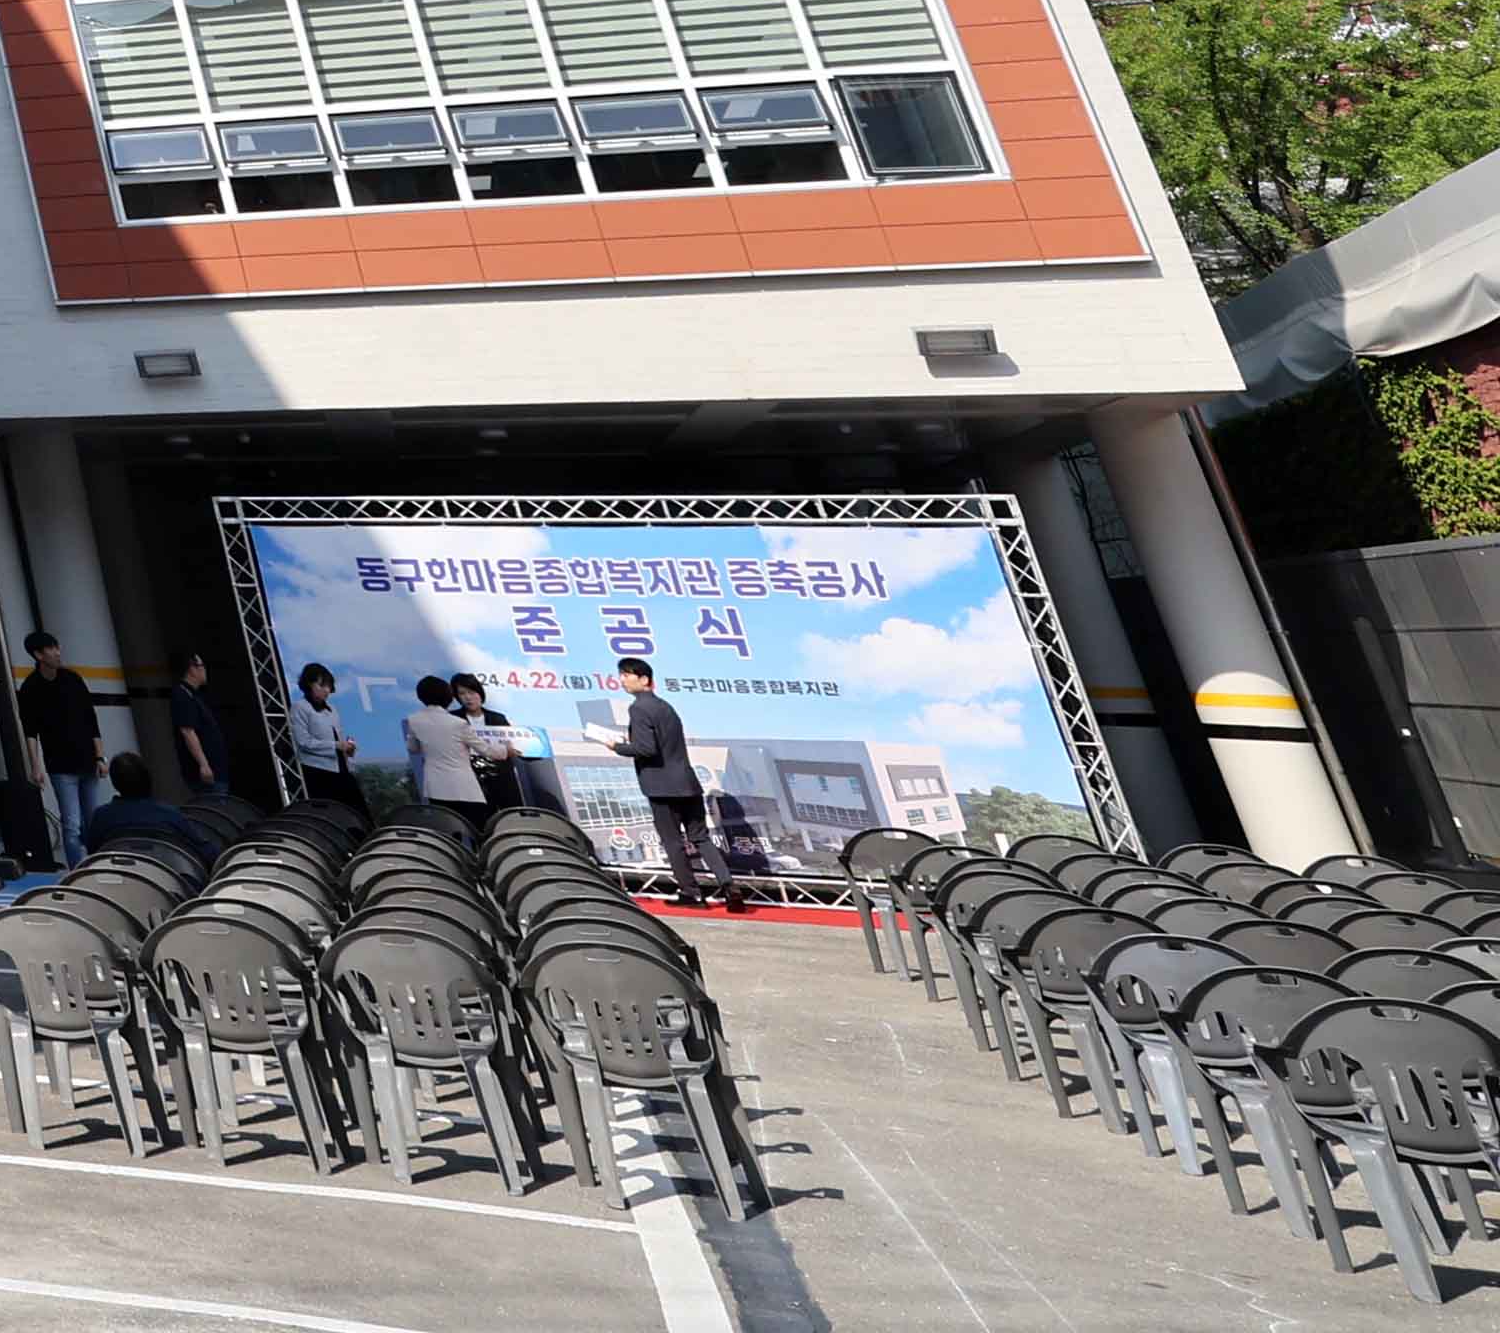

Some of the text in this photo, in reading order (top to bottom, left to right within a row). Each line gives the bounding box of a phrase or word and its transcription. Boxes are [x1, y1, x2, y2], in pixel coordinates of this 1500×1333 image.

[356, 555, 888, 601] 동구한마음종합복지관 증축공사
[510, 605, 751, 658] 준 공 식
[663, 676, 841, 697] 동구한마음종합복지관
